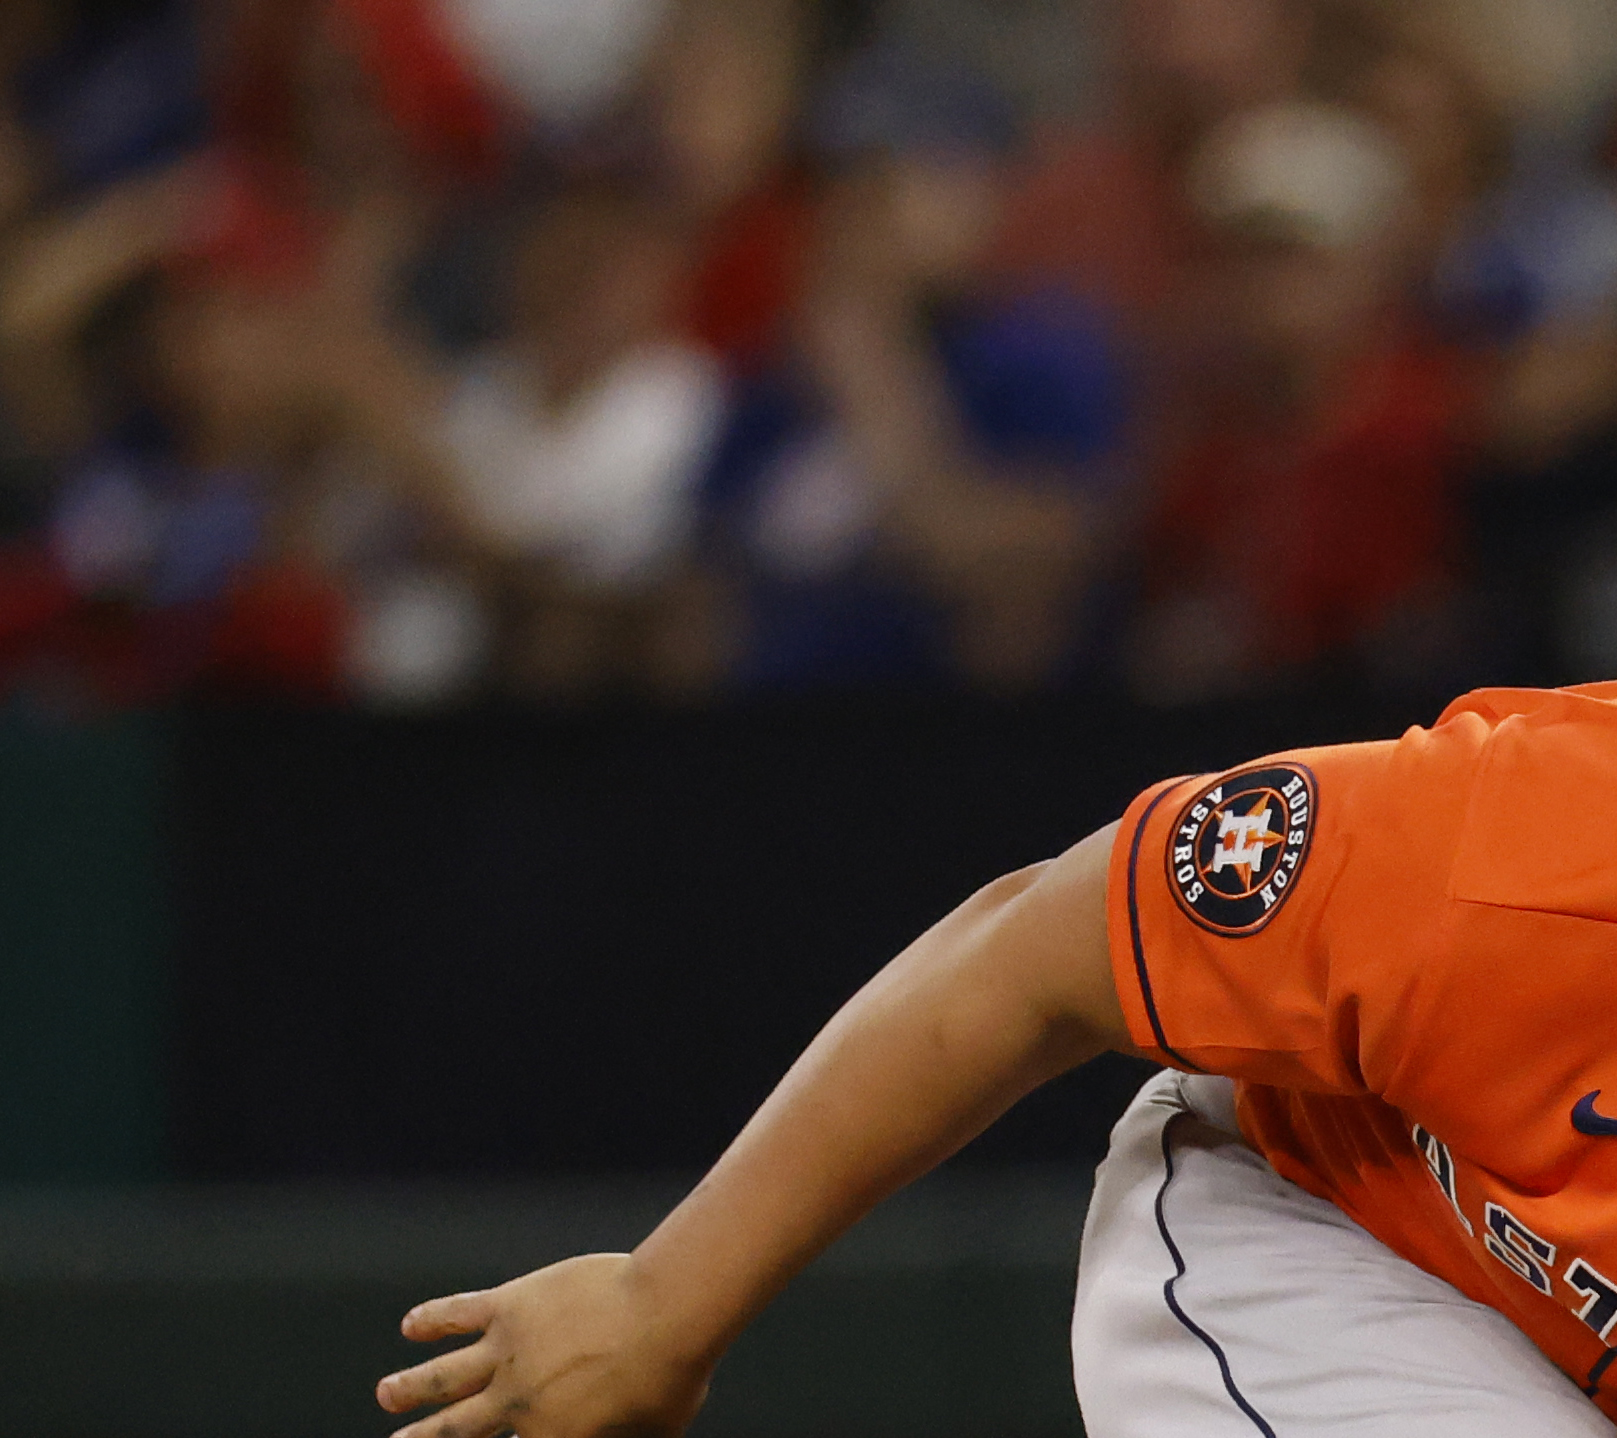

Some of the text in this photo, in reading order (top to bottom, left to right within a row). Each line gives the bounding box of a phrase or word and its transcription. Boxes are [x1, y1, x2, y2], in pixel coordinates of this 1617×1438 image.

[1174, 785, 1225, 903] ASTROS
[1212, 808, 1273, 874] H
[1259, 775, 1309, 910] HOUSTON
